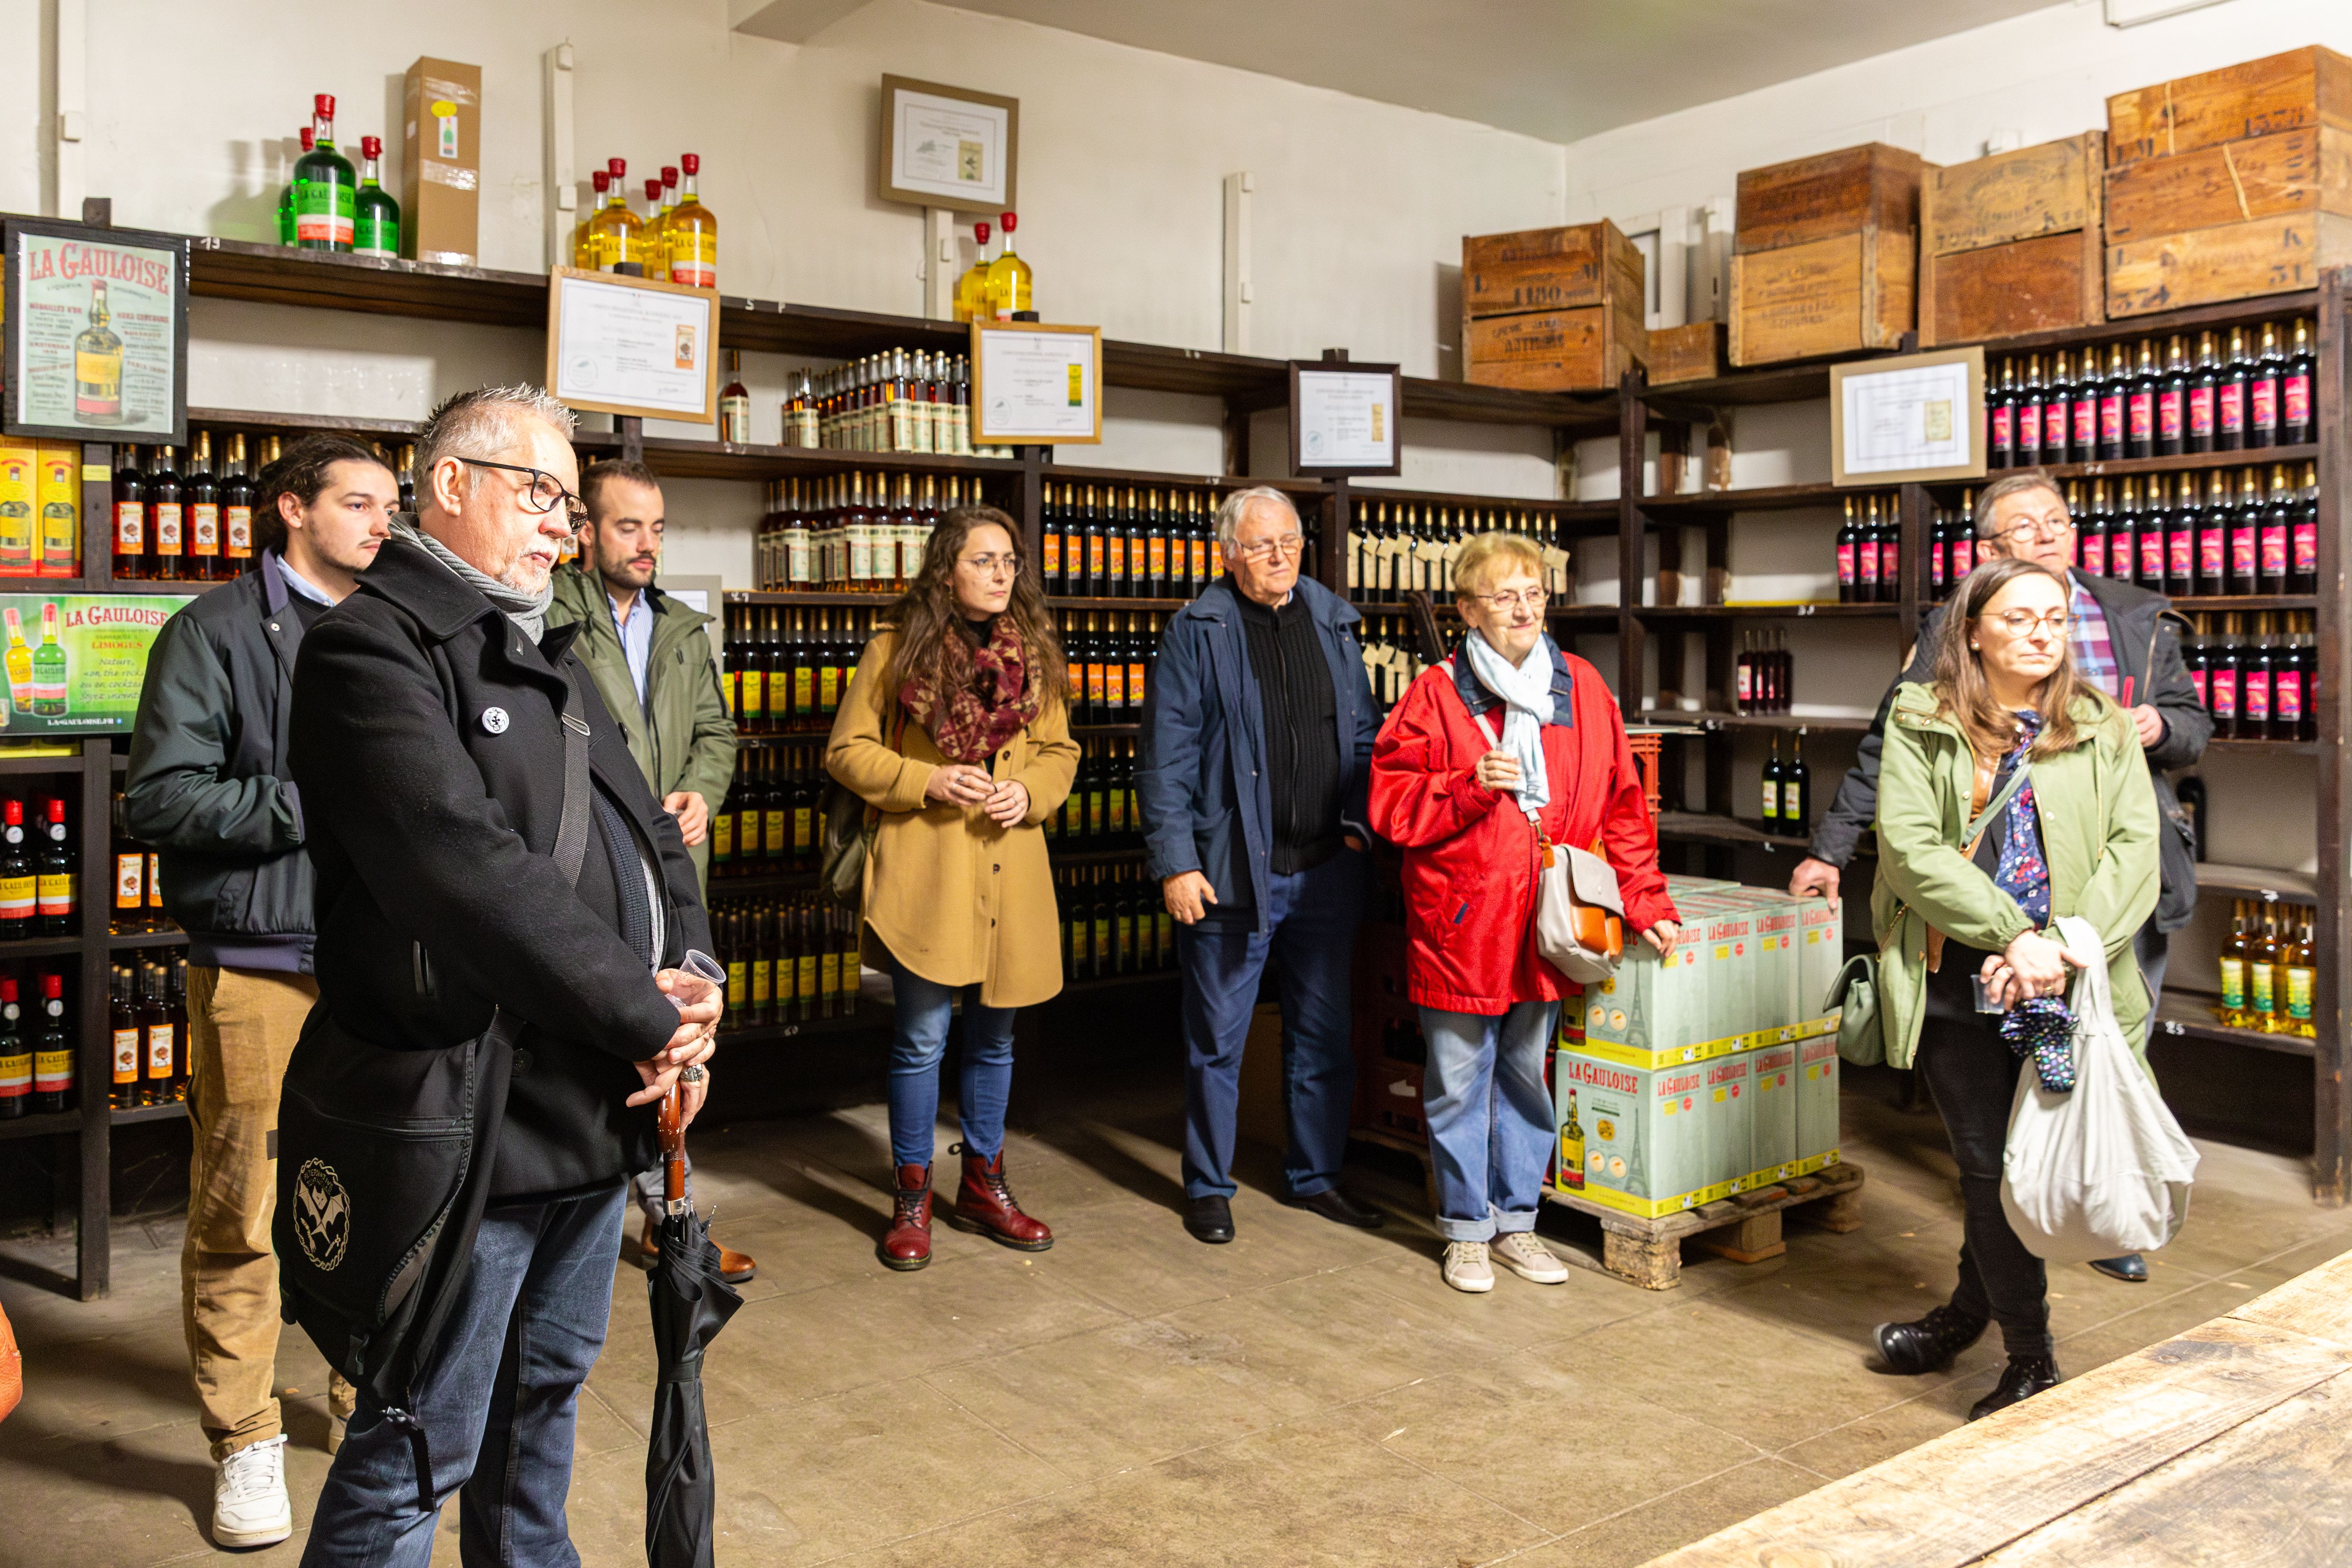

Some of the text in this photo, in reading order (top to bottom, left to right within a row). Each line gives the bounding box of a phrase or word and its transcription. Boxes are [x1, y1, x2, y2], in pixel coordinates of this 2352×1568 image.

[29, 243, 169, 296] LA GAULOISE
[66, 606, 168, 627] LA GAULOISE
[92, 641, 143, 650] LIMOGES
[1708, 925, 1716, 941] LA
[1568, 1060, 1638, 1095] LA GAULOISE
[1658, 1073, 1700, 1097] LA GAULOISE
